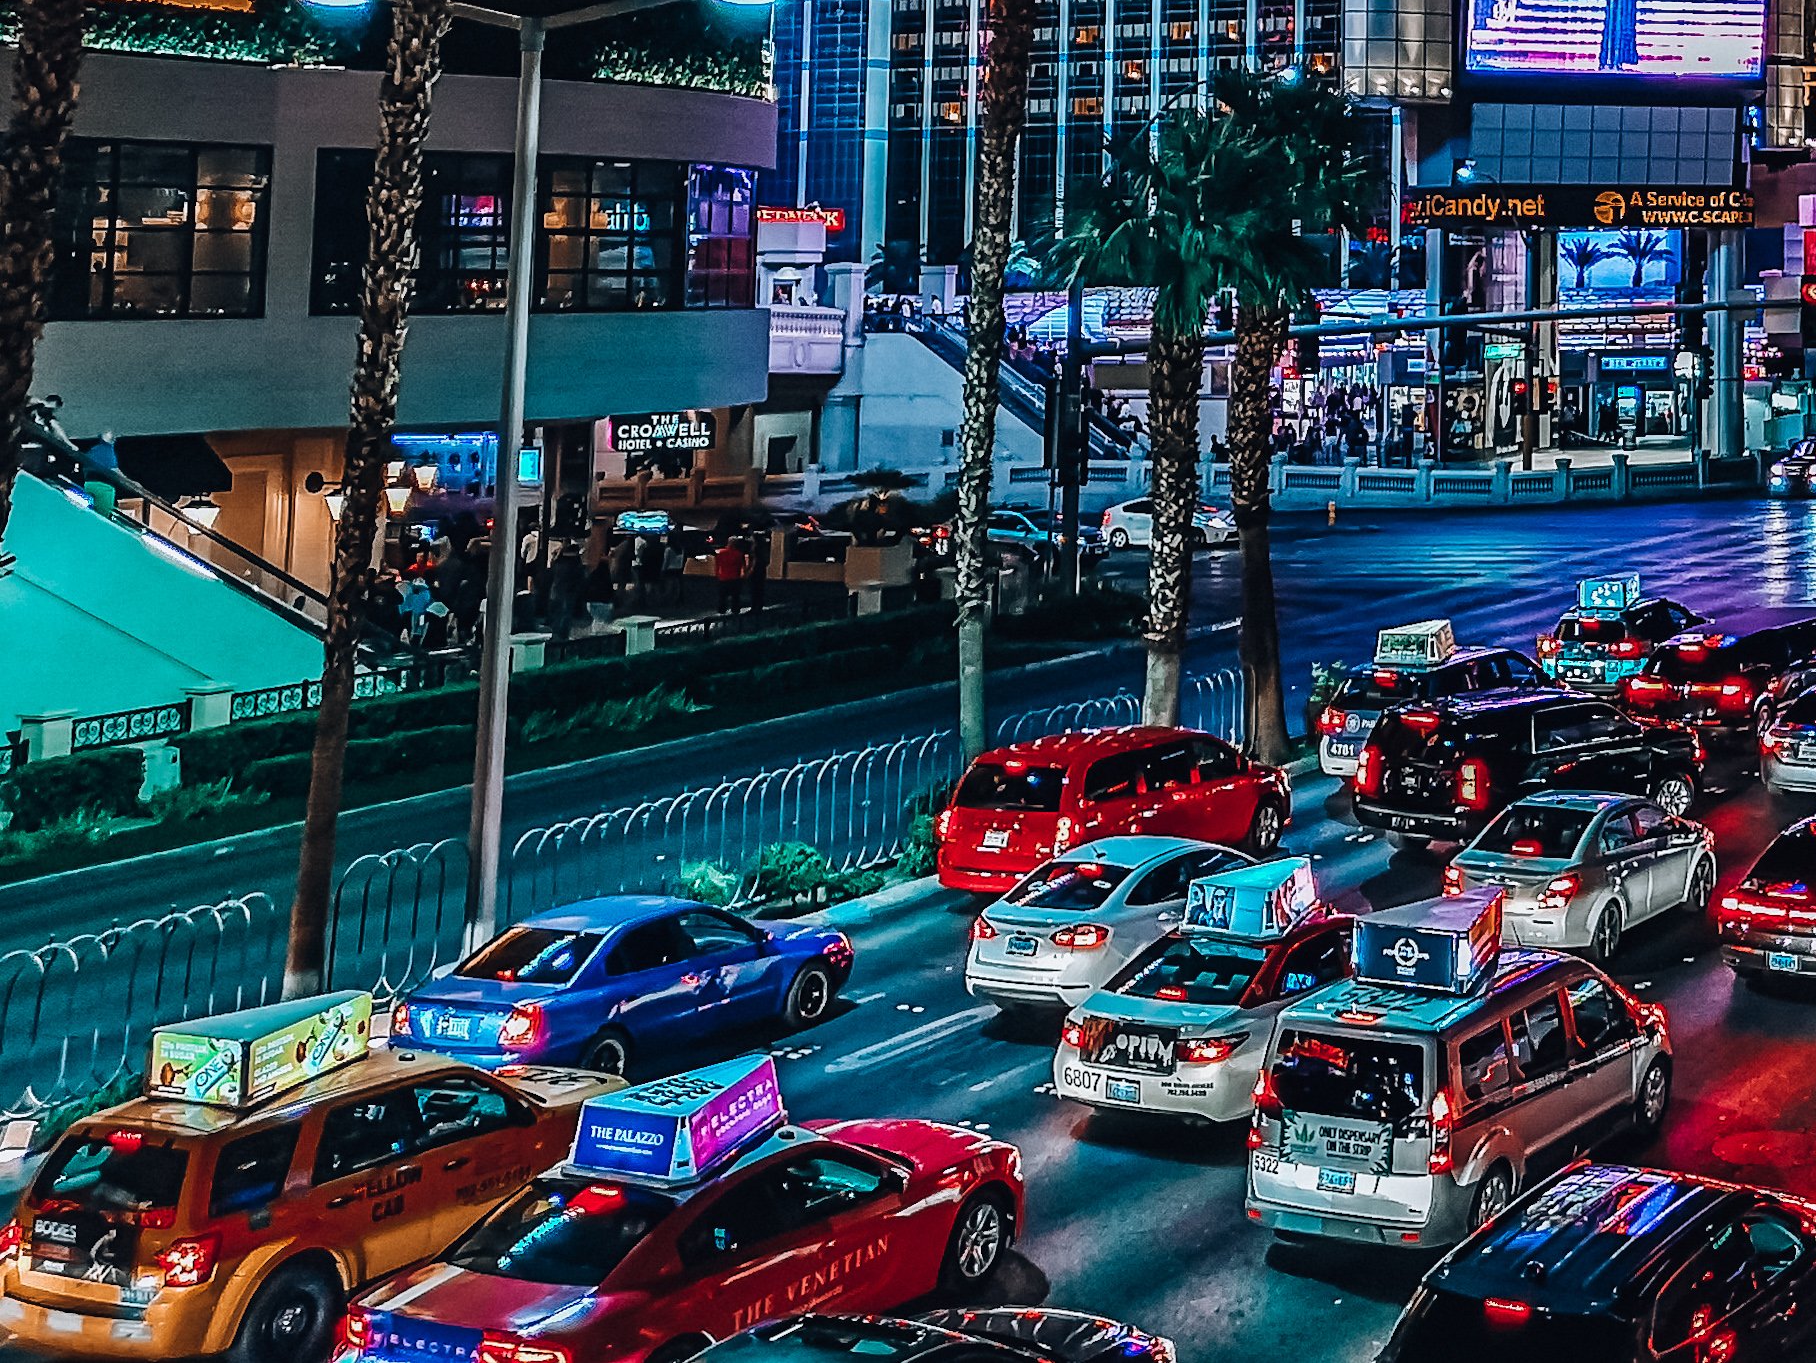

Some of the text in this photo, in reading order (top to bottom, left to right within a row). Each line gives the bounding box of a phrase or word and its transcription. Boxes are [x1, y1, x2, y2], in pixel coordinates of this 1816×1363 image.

[1630, 192, 1643, 207] A
[1647, 191, 1705, 207] Service
[1709, 191, 1725, 207] of
[651, 414, 679, 426] THE
[617, 425, 711, 439] CROMWELL
[618, 438, 709, 451] HOTEL CASINO
[1115, 1033, 1174, 1067] OPIUM
[1064, 1066, 1101, 1092] 6807
[591, 1125, 664, 1146] THE PALAZZO
[1319, 1125, 1381, 1145] ONLY DISPENSARY
[1352, 1143, 1373, 1157] STRIP
[1253, 1154, 1280, 1175] 5322
[732, 1293, 775, 1332] THE
[786, 1233, 893, 1302] VENETIAN
[388, 1334, 481, 1360] ELECTRA
